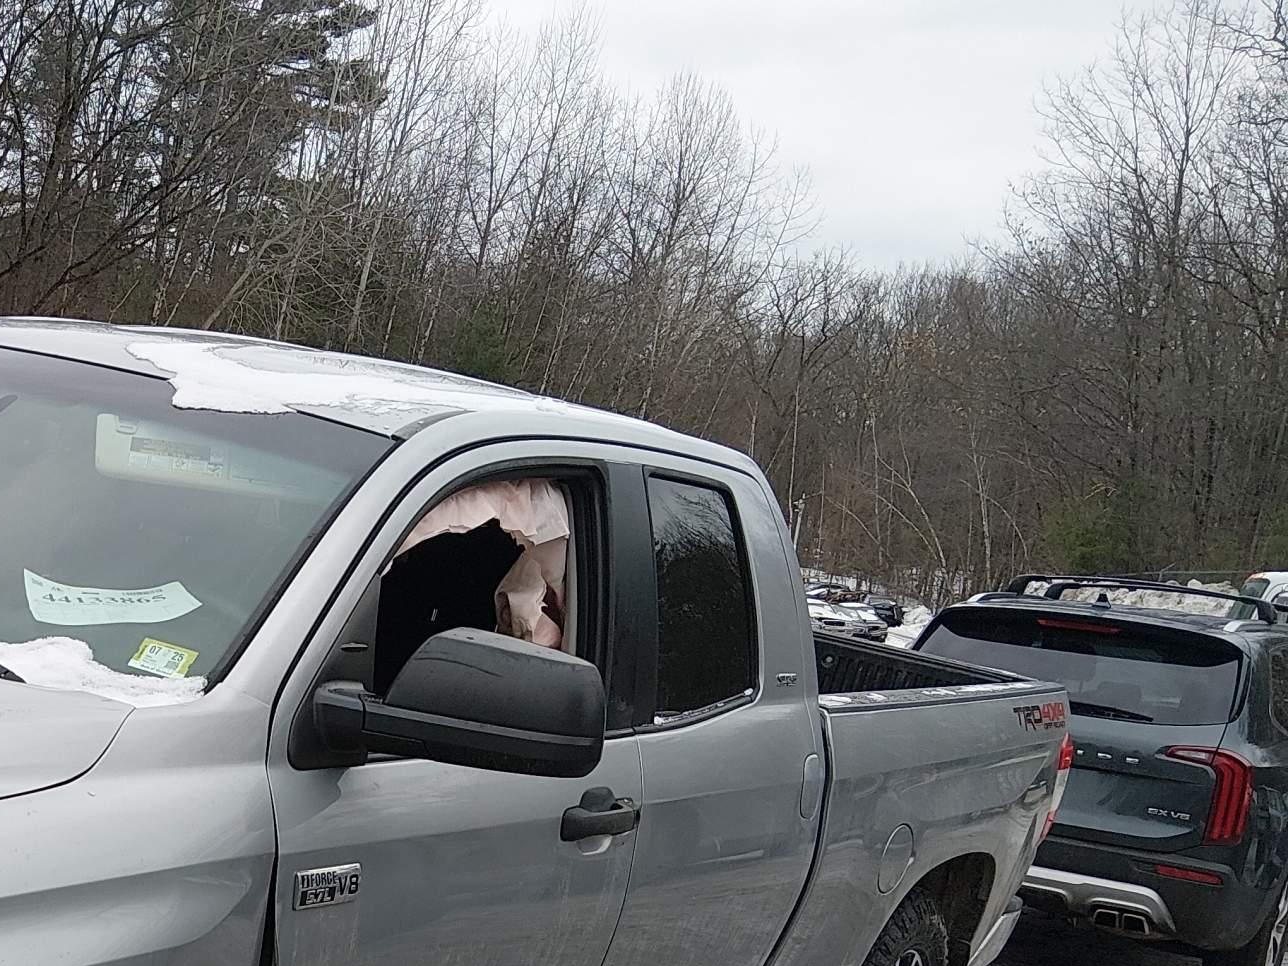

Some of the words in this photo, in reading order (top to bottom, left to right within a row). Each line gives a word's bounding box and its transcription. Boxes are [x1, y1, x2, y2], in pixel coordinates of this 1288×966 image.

[149, 645, 162, 656] 07
[171, 652, 185, 662] 25
[1013, 705, 1043, 731] TRD
[338, 873, 360, 896] V8
